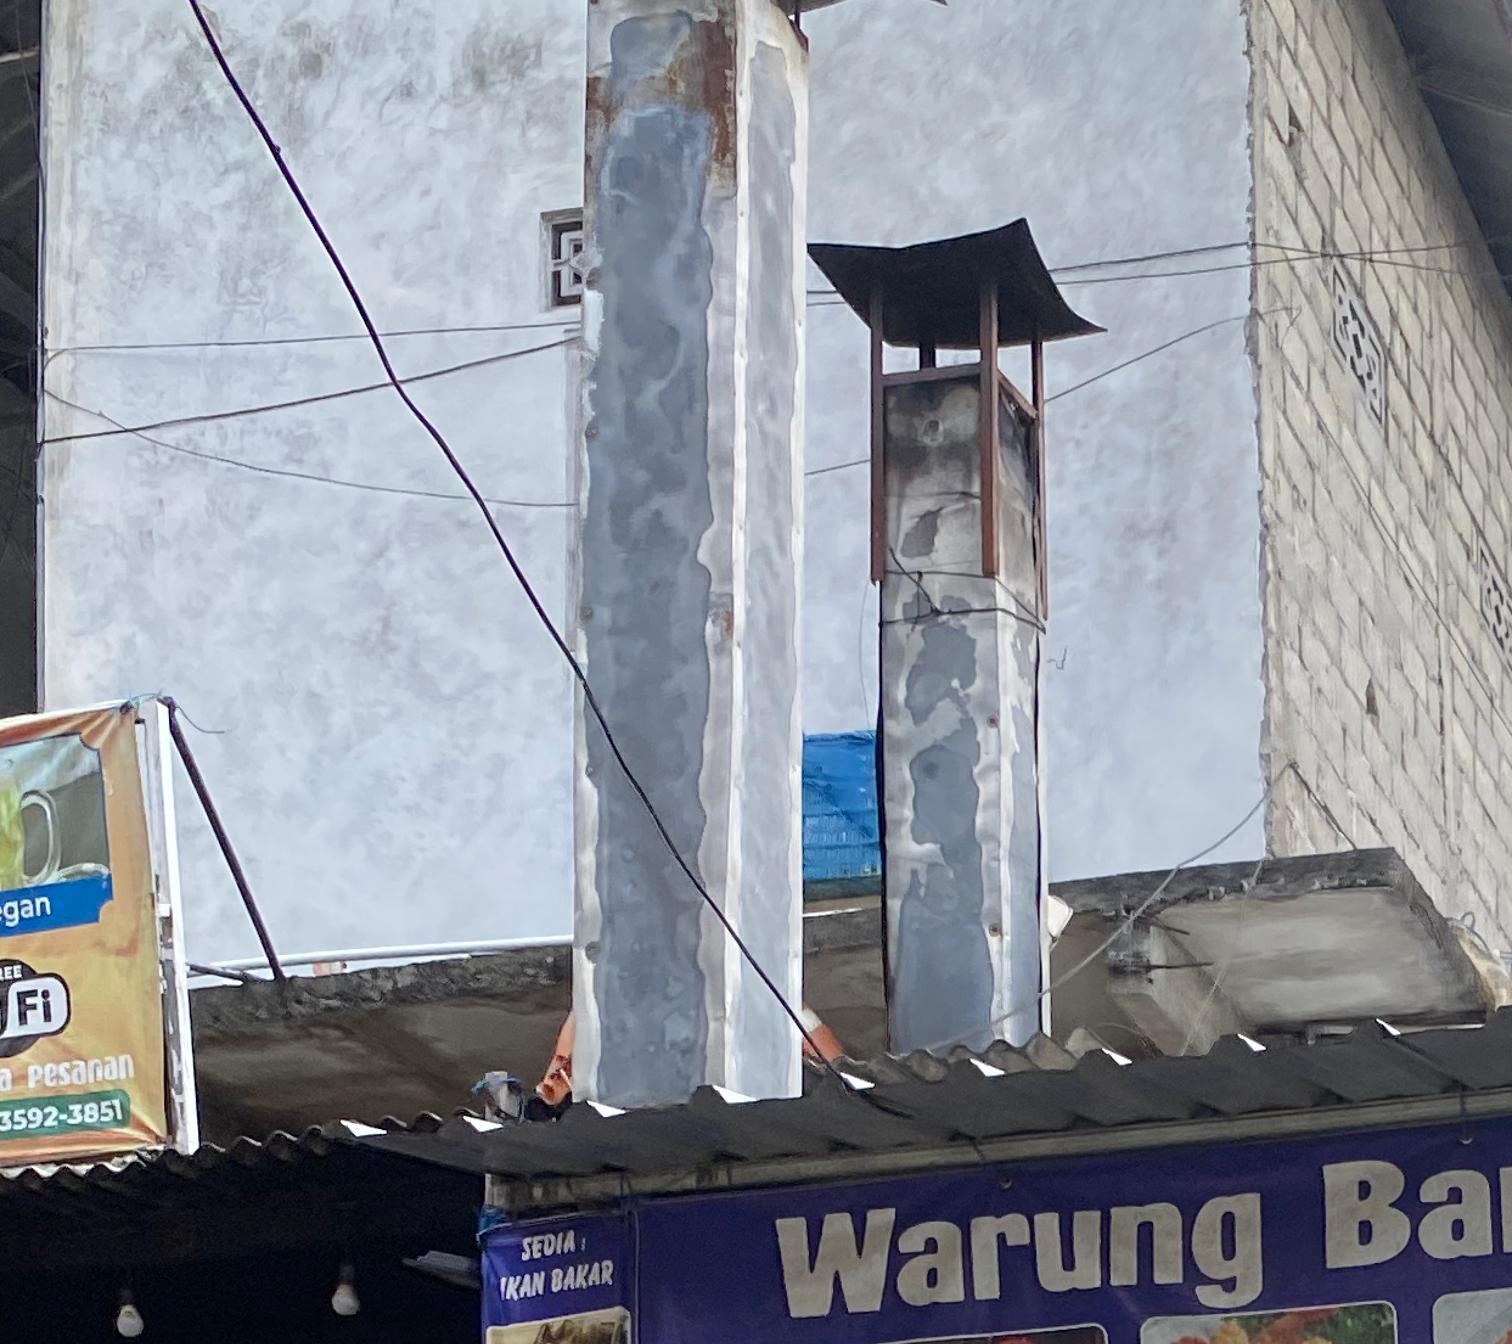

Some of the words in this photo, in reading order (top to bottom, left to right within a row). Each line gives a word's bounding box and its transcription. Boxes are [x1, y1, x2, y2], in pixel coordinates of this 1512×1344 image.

[0, 896, 51, 928] gan
[16, 989, 52, 1027] Fi
[521, 1230, 576, 1262] SEDIA
[774, 1192, 1263, 1319] Warung
[500, 1271, 546, 1301] IKAN
[551, 1260, 614, 1293] BAKAR
